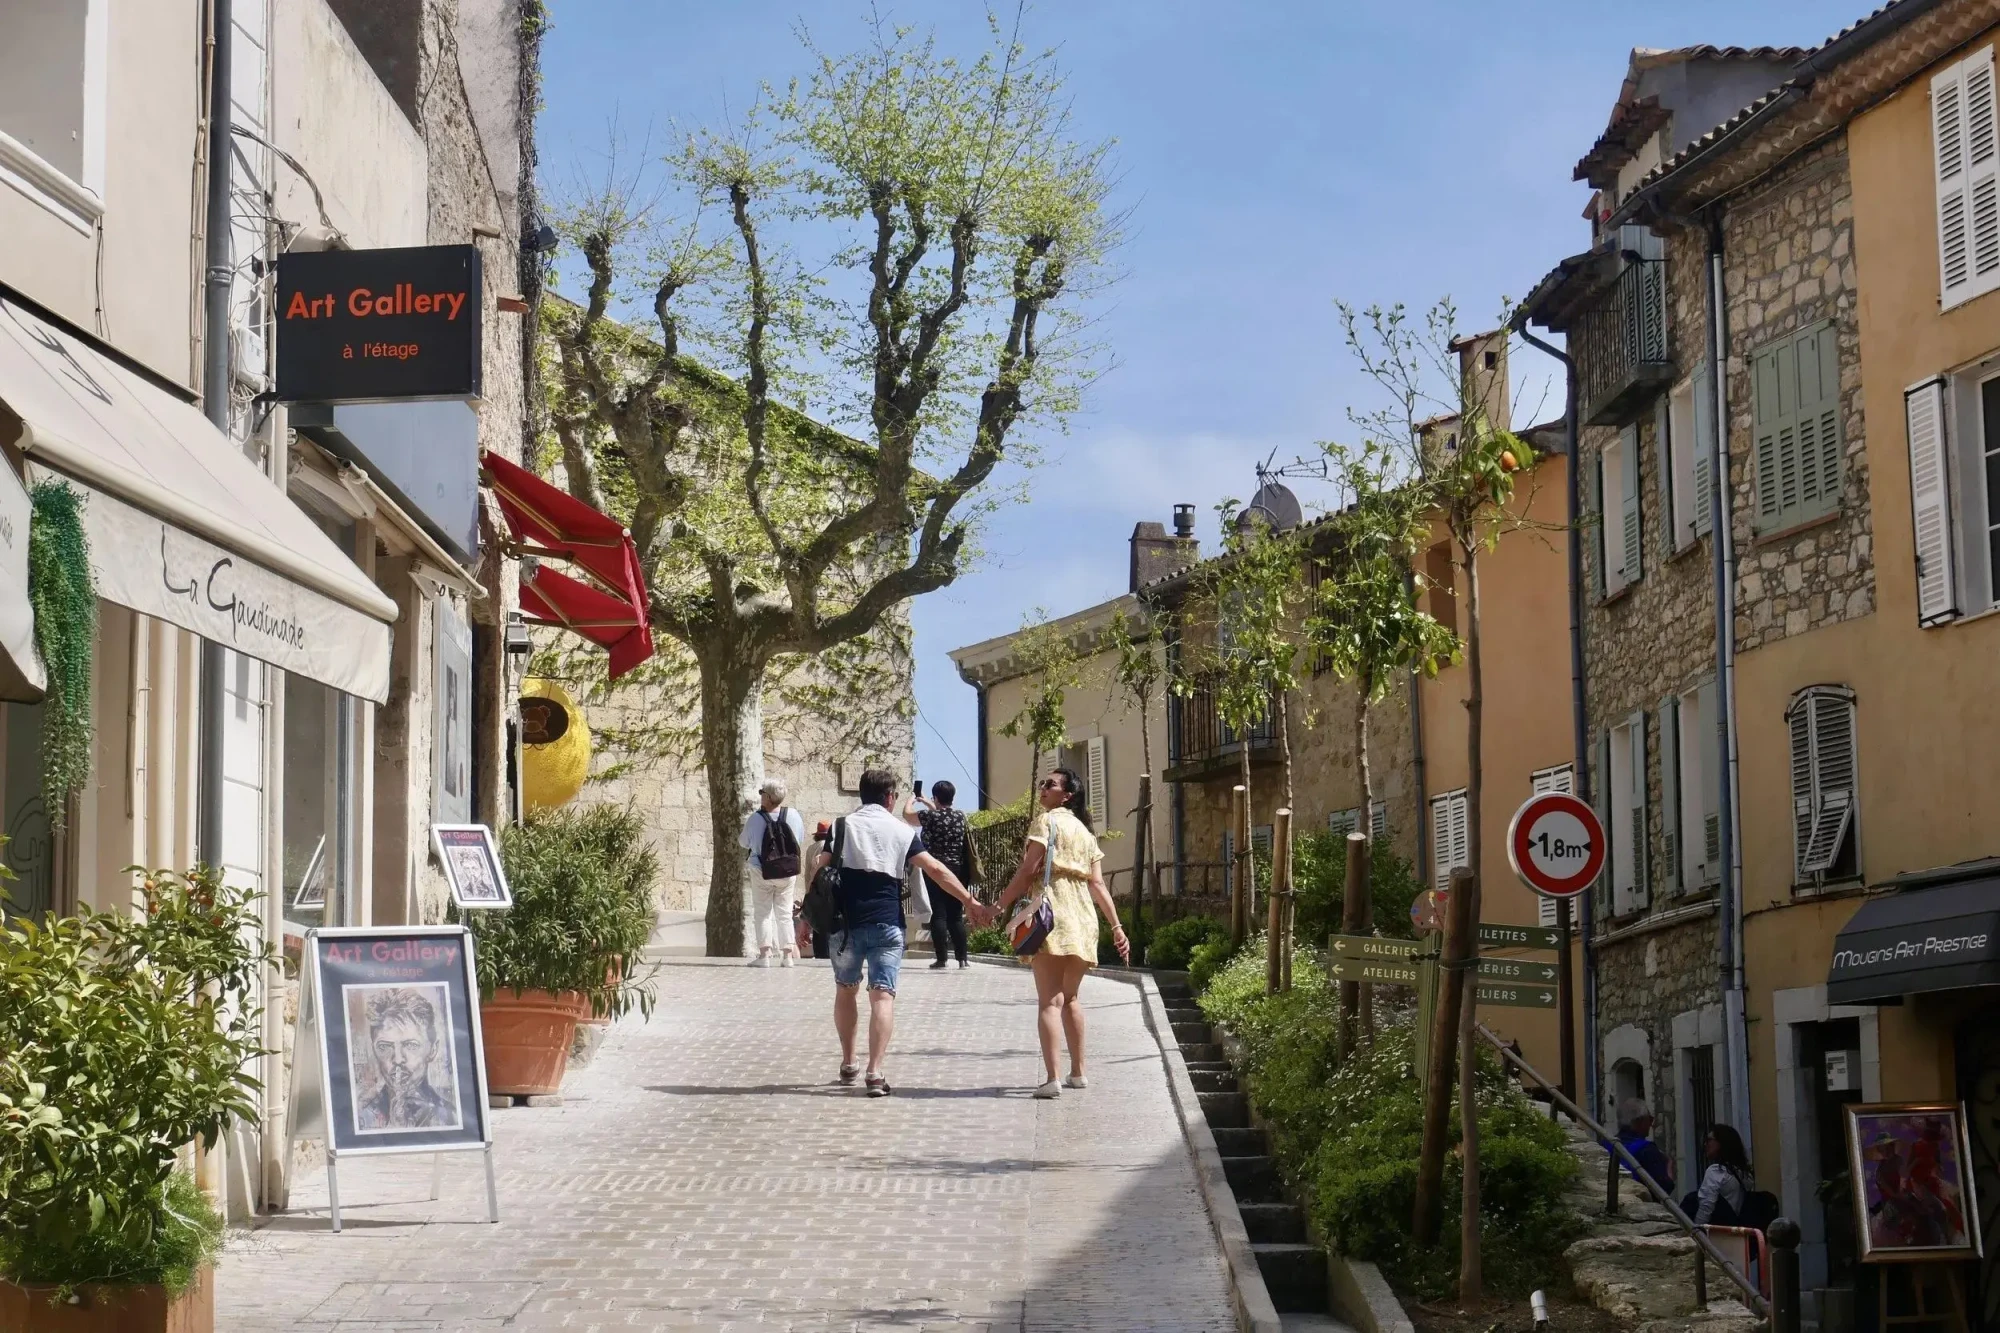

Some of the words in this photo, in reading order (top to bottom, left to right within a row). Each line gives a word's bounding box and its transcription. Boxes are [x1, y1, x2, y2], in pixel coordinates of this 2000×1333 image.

[286, 291, 335, 319] Art
[348, 284, 465, 320] Gallery
[343, 344, 353, 359] à
[364, 342, 419, 360] l'étage
[161, 525, 198, 605] La
[207, 557, 304, 650] Gaudinade
[1538, 832, 1582, 861] 1,8m
[1479, 928, 1527, 942] ILETTES
[326, 941, 362, 964] Art
[371, 939, 458, 967] Gallery
[1363, 943, 1418, 957] GALERIES
[1363, 967, 1417, 981] ATELIERS
[1477, 963, 1520, 976] LERIES
